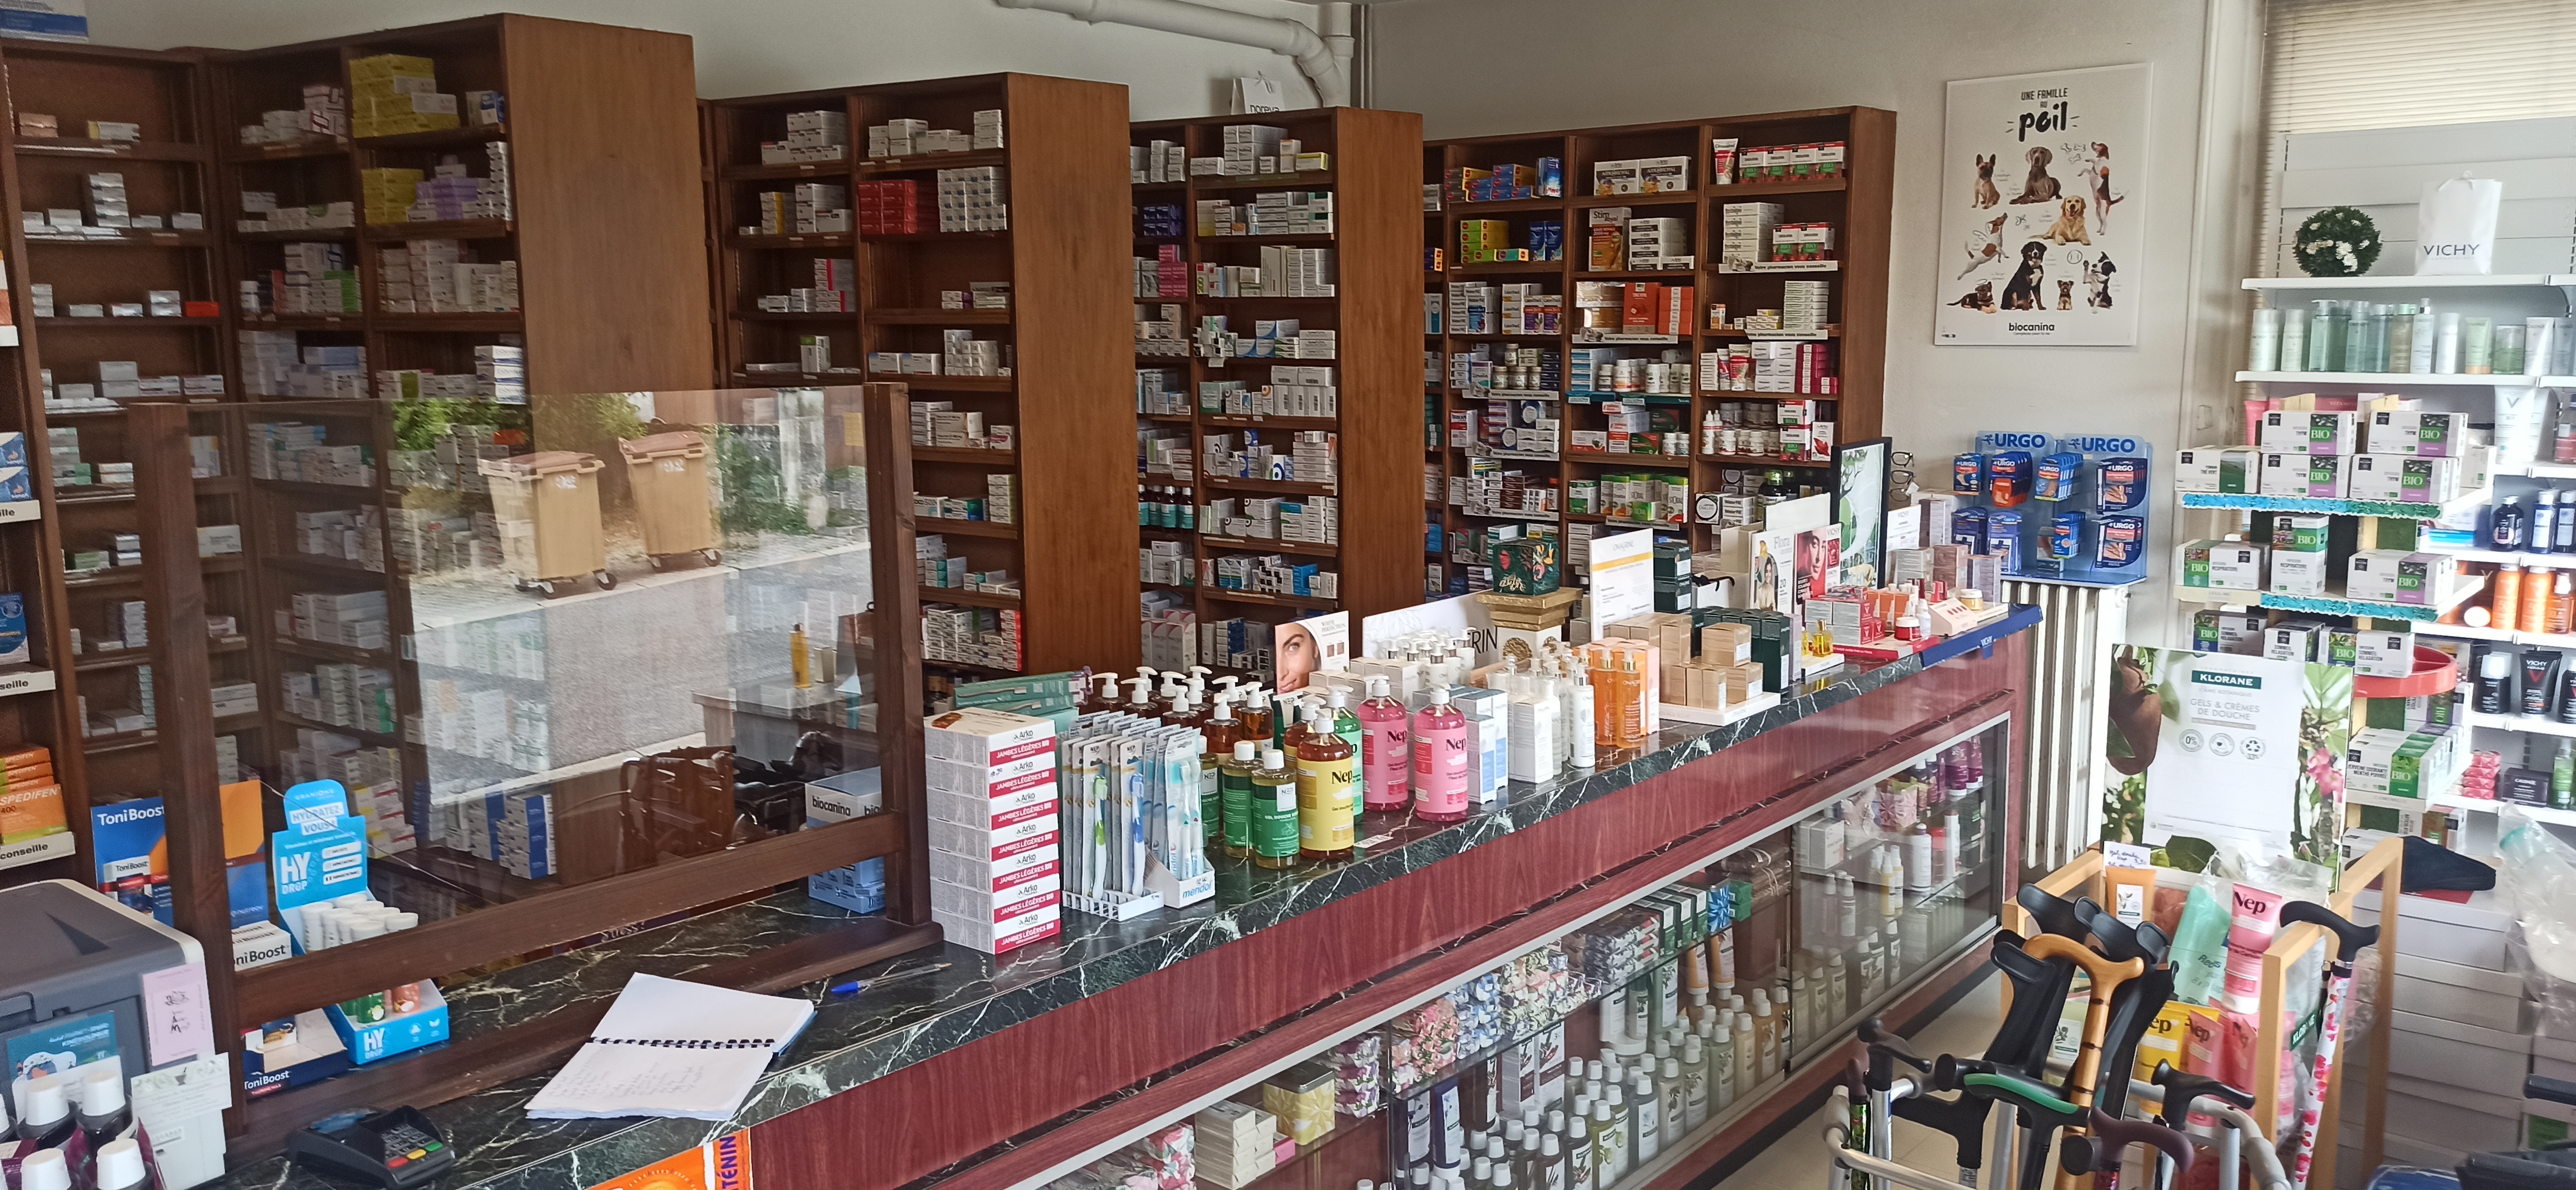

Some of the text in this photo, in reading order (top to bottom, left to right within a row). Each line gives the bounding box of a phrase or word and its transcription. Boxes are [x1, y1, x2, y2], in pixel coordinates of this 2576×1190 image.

[2021, 87, 2068, 100] UNE FAMILLE
[2019, 101, 2068, 142] poil
[2424, 244, 2481, 256] VICHY
[2009, 323, 2055, 331] biocanina
[1995, 433, 2046, 448] URGO
[2311, 430, 2330, 438] BIO
[2421, 430, 2440, 439] BIO
[2082, 437, 2136, 453] URGO
[2310, 472, 2329, 481] BIO
[2403, 476, 2423, 485] BIO
[1774, 536, 1790, 549] Flora
[2298, 535, 2316, 544] BIO
[2398, 577, 2418, 587] BIO
[2201, 628, 2217, 638] BIO
[2336, 648, 2355, 659] BIO
[2200, 674, 2253, 686] KLORANE
[2190, 699, 2211, 707] GELS
[2224, 702, 2260, 713] CRÈMES
[2212, 710, 2251, 720] DOUCHE
[2436, 707, 2445, 722] BIO
[1387, 730, 1407, 743] Nep
[2185, 736, 2197, 745] 0%
[997, 748, 1017, 758] JAMBES
[1018, 742, 1041, 752] LÉGÈRES
[1446, 738, 1466, 751] Nep
[1019, 761, 1033, 770] Arko
[996, 779, 1017, 790] JAMBES
[1017, 773, 1041, 784] LÉGÈRES
[1332, 770, 1352, 784] Nep
[2391, 770, 2411, 781] BIO
[0, 788, 58, 806] SPEDIFEN
[1021, 792, 1035, 801] Arko
[812, 795, 851, 816] biocanina
[998, 811, 1019, 822] JAMBES
[1019, 804, 1043, 815] LÉGÈRES
[1022, 823, 1036, 832] Arko
[0, 843, 48, 860] conseille
[999, 842, 1020, 854] JAMBES
[1020, 836, 1044, 847] LÉGÈRES
[1022, 854, 1036, 863] Arko
[281, 851, 311, 884] HY
[999, 872, 1021, 884] JAMBES
[1021, 865, 1045, 876] LÉGÈRES
[282, 880, 308, 895] DROP
[1024, 884, 1038, 893] Arko
[1182, 882, 1212, 899] meridol
[1001, 903, 1022, 915] JAMBES
[1022, 896, 1046, 908] LÉGÈRES
[2233, 891, 2266, 915] Nep
[1024, 914, 1038, 923] Arko
[1002, 933, 1023, 945] JAMBES
[1023, 926, 1046, 938] LÉGÈRES
[364, 1028, 385, 1051] HY
[717, 1136, 739, 1190] TÉNIN
